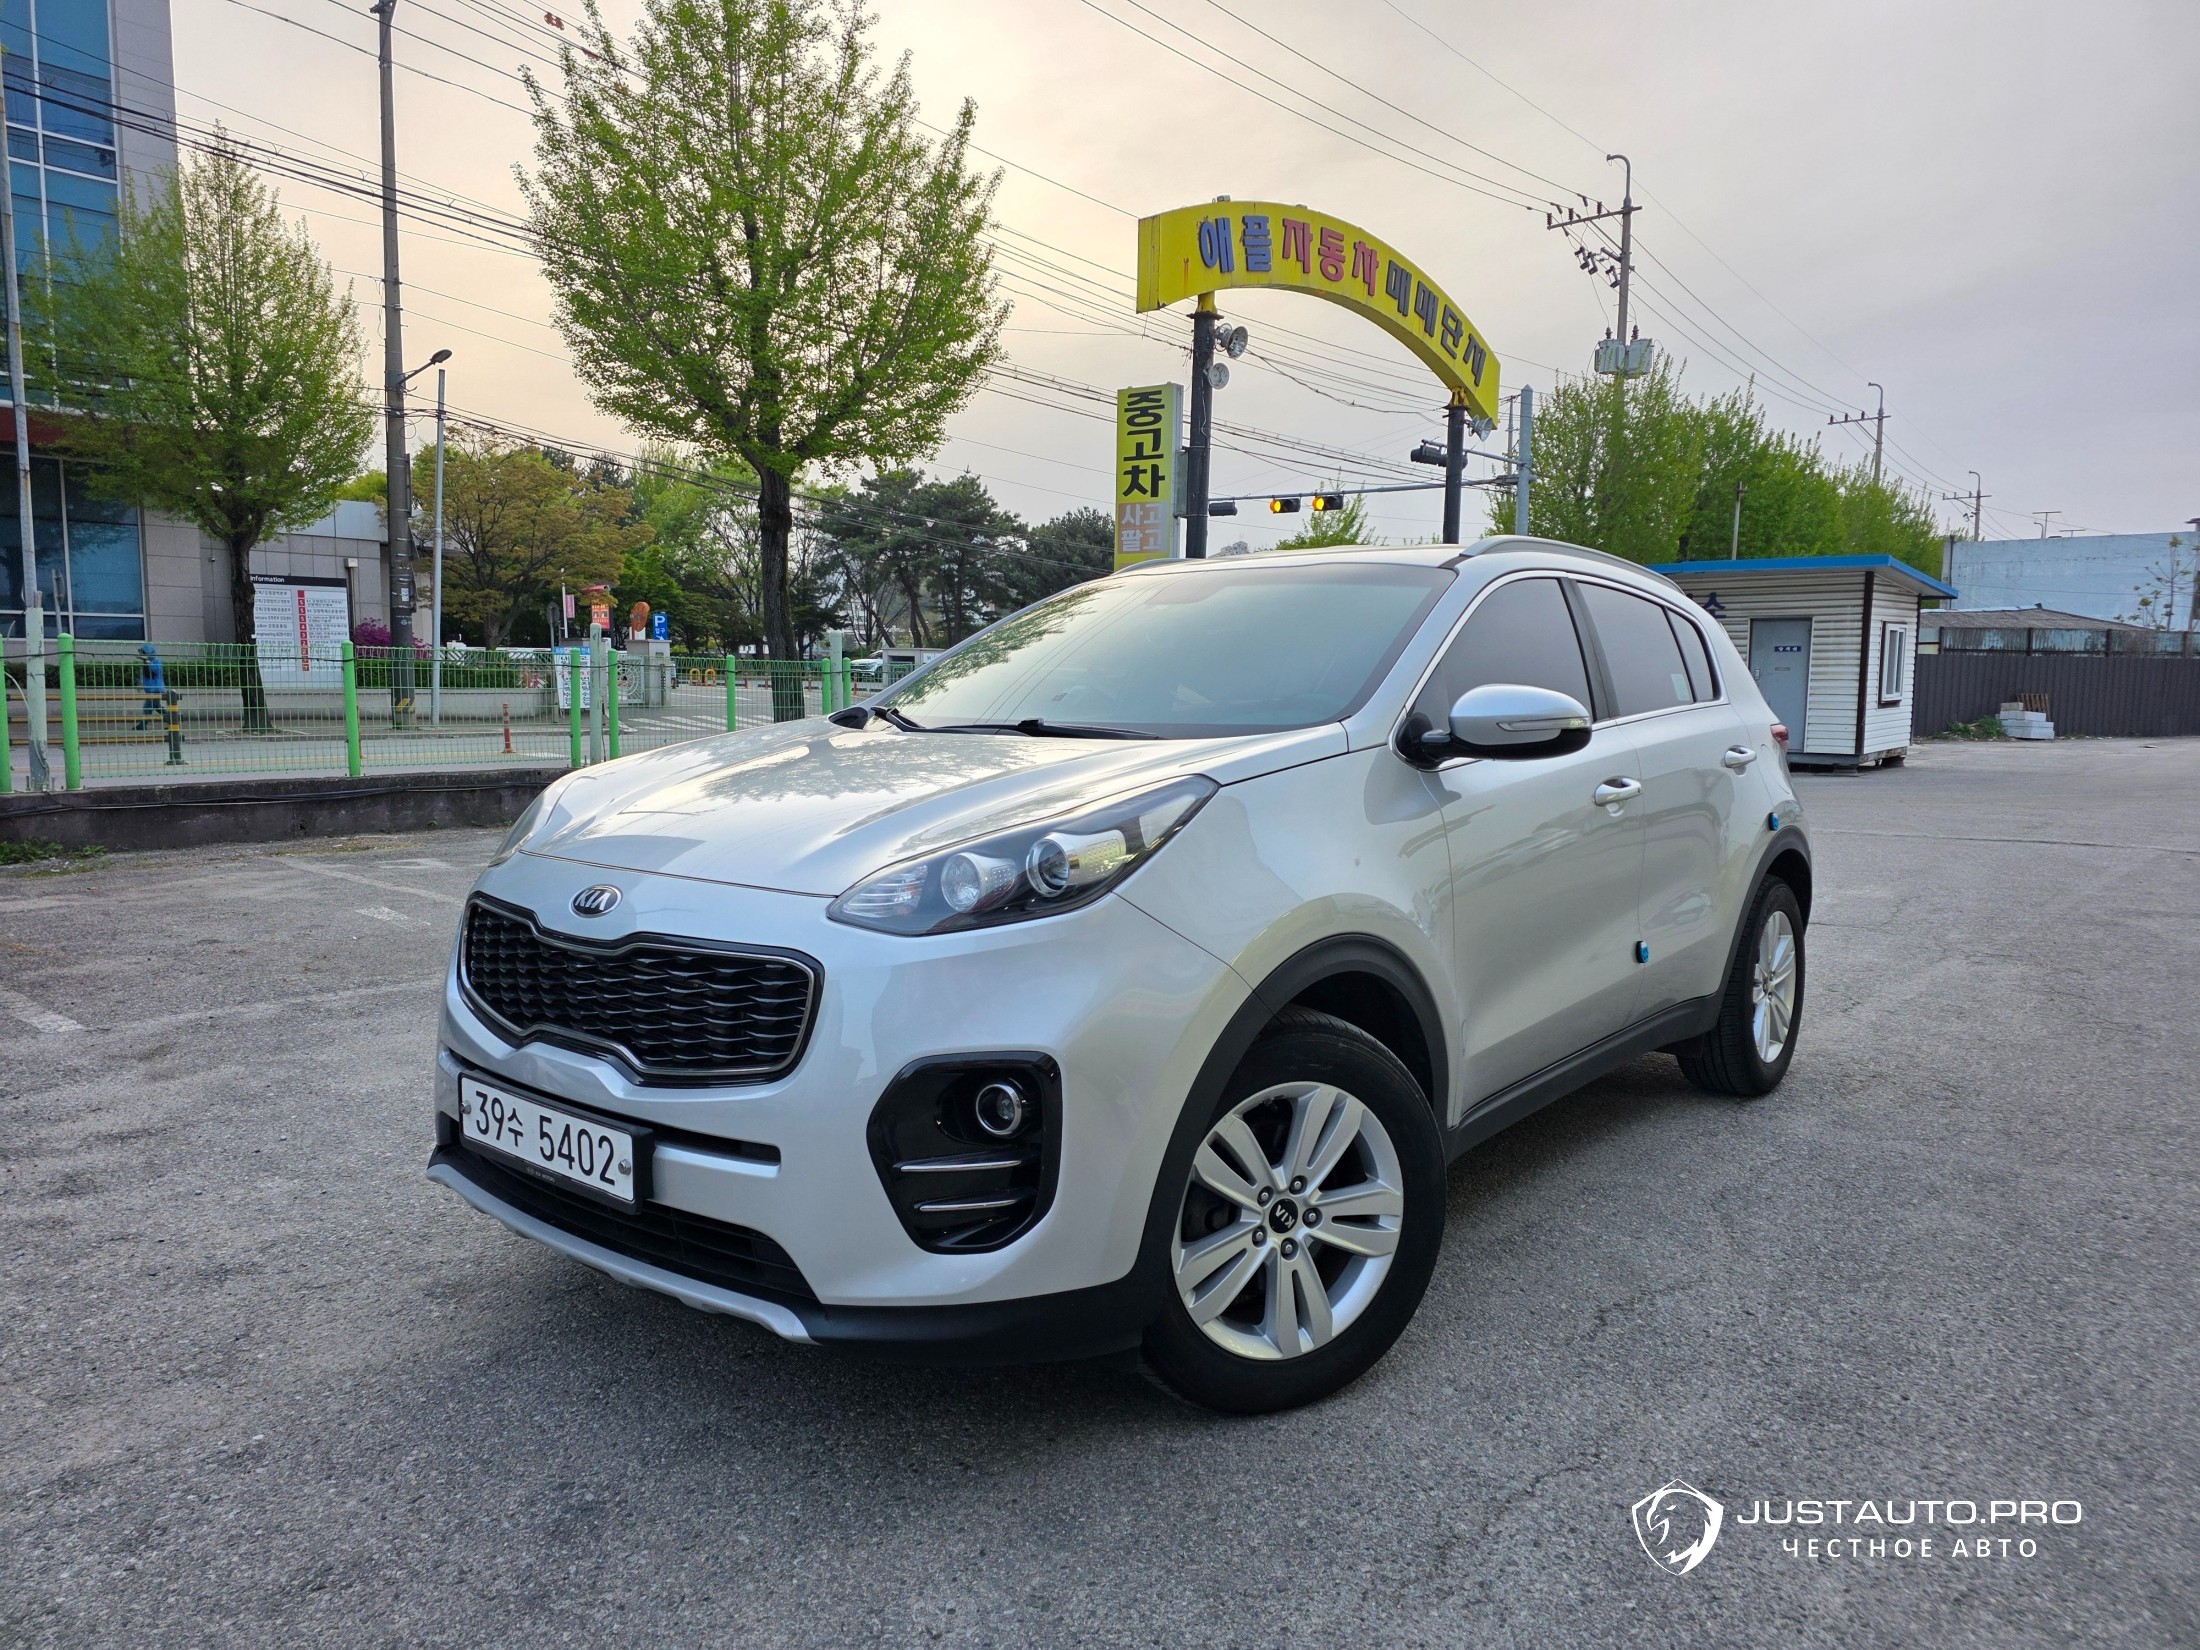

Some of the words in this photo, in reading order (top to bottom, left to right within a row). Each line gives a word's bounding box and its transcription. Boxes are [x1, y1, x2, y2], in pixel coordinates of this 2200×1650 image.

[1199, 215, 1272, 274] 애플
[1282, 217, 1380, 297] 자동차
[1386, 259, 1488, 388] 매매단지
[1122, 390, 1166, 498] 중고차
[1121, 503, 1167, 526] 사고
[1121, 529, 1167, 552] 팔고
[655, 615, 666, 627] P
[574, 889, 612, 911] KIA
[475, 1091, 524, 1148] 39수
[539, 1115, 616, 1186] 5402
[1275, 1204, 1295, 1229] KIA
